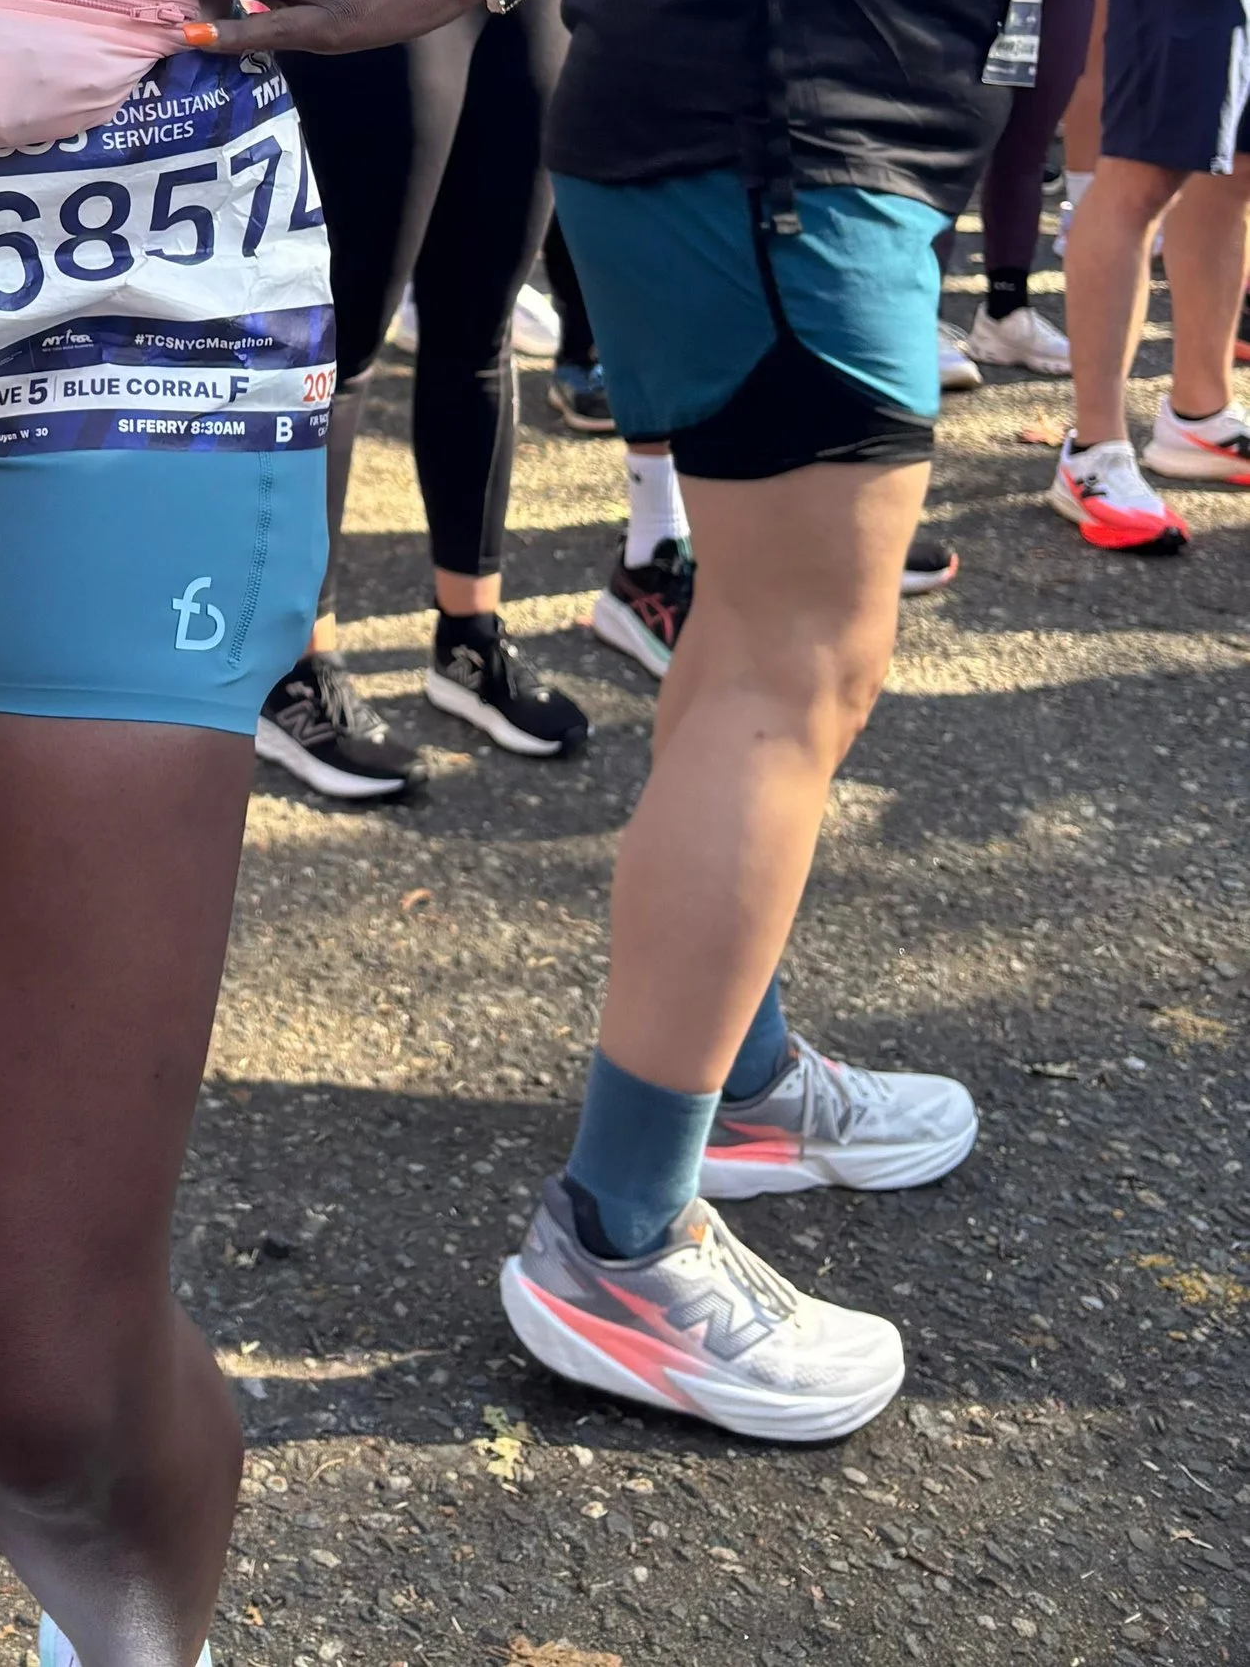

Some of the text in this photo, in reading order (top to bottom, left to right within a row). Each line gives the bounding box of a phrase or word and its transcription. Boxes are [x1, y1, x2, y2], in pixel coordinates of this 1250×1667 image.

[102, 120, 195, 151] SERVICES
[134, 333, 274, 352] #TCSNYCMarathon
[27, 376, 49, 406] 5
[62, 378, 121, 398] BLUE
[125, 377, 224, 399] CORRAL
[227, 374, 250, 404] F
[20, 429, 30, 439] W
[35, 427, 49, 438] 30
[117, 416, 294, 444] SI FERRY 8:30AM B
